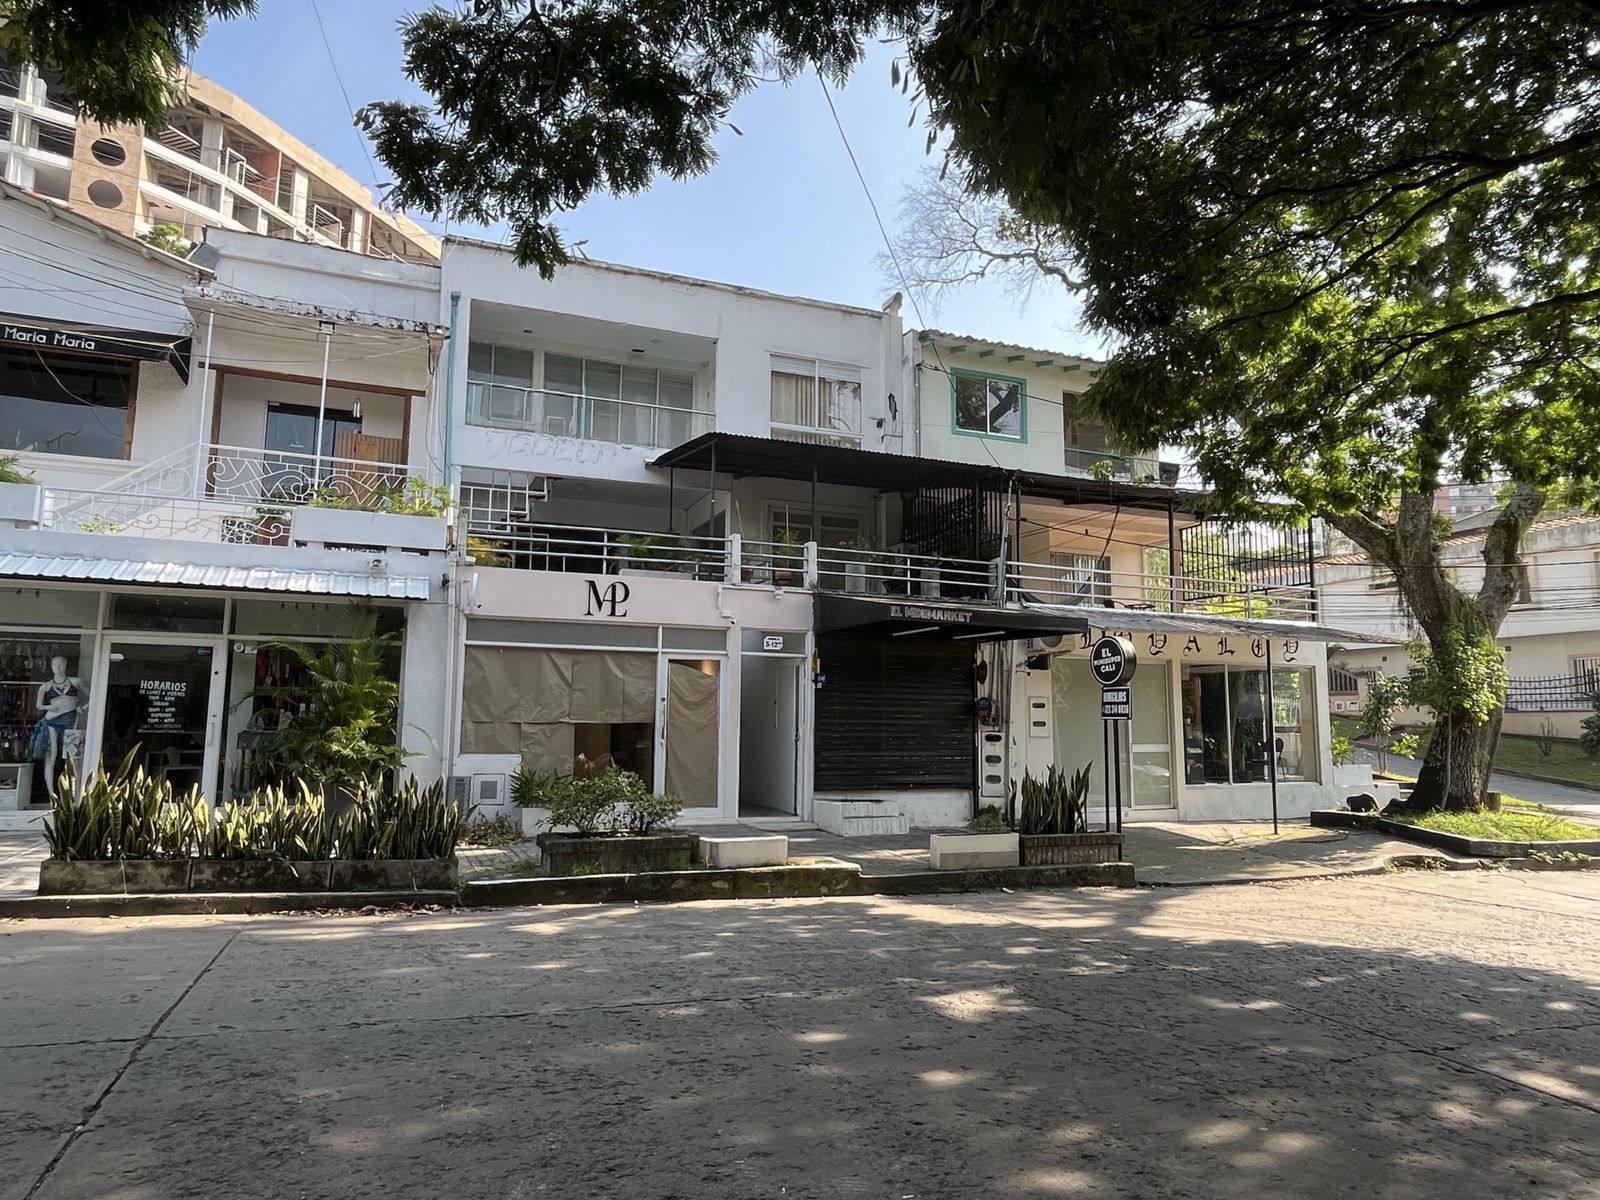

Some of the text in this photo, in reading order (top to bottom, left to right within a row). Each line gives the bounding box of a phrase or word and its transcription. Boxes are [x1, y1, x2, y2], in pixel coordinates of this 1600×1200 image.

[4, 326, 96, 350] Maria Maria
[890, 605, 973, 623] EL MINIMARKET
[1101, 647, 1112, 658] EL
[1093, 656, 1121, 666] MINISUPER
[1100, 663, 1116, 673] CALI
[140, 680, 187, 691] HORARIOS
